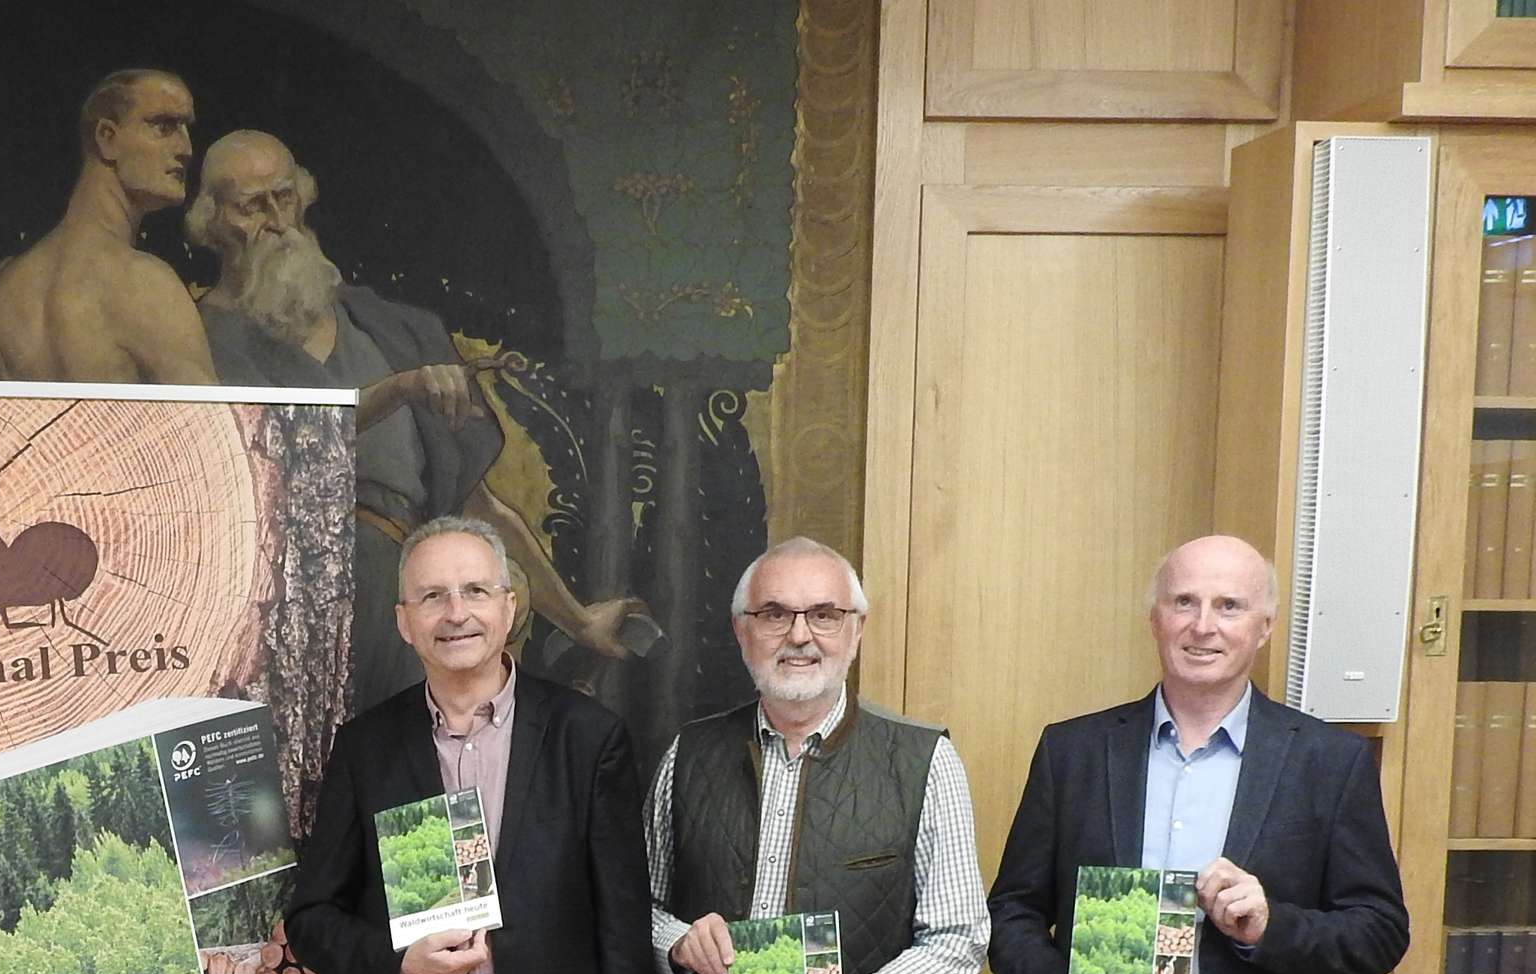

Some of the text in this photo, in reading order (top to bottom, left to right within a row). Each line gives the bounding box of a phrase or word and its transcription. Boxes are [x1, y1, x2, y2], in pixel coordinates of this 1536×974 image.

[70, 633, 191, 678] Preis
[201, 731, 222, 745] PEFC
[173, 767, 202, 782] PEFC
